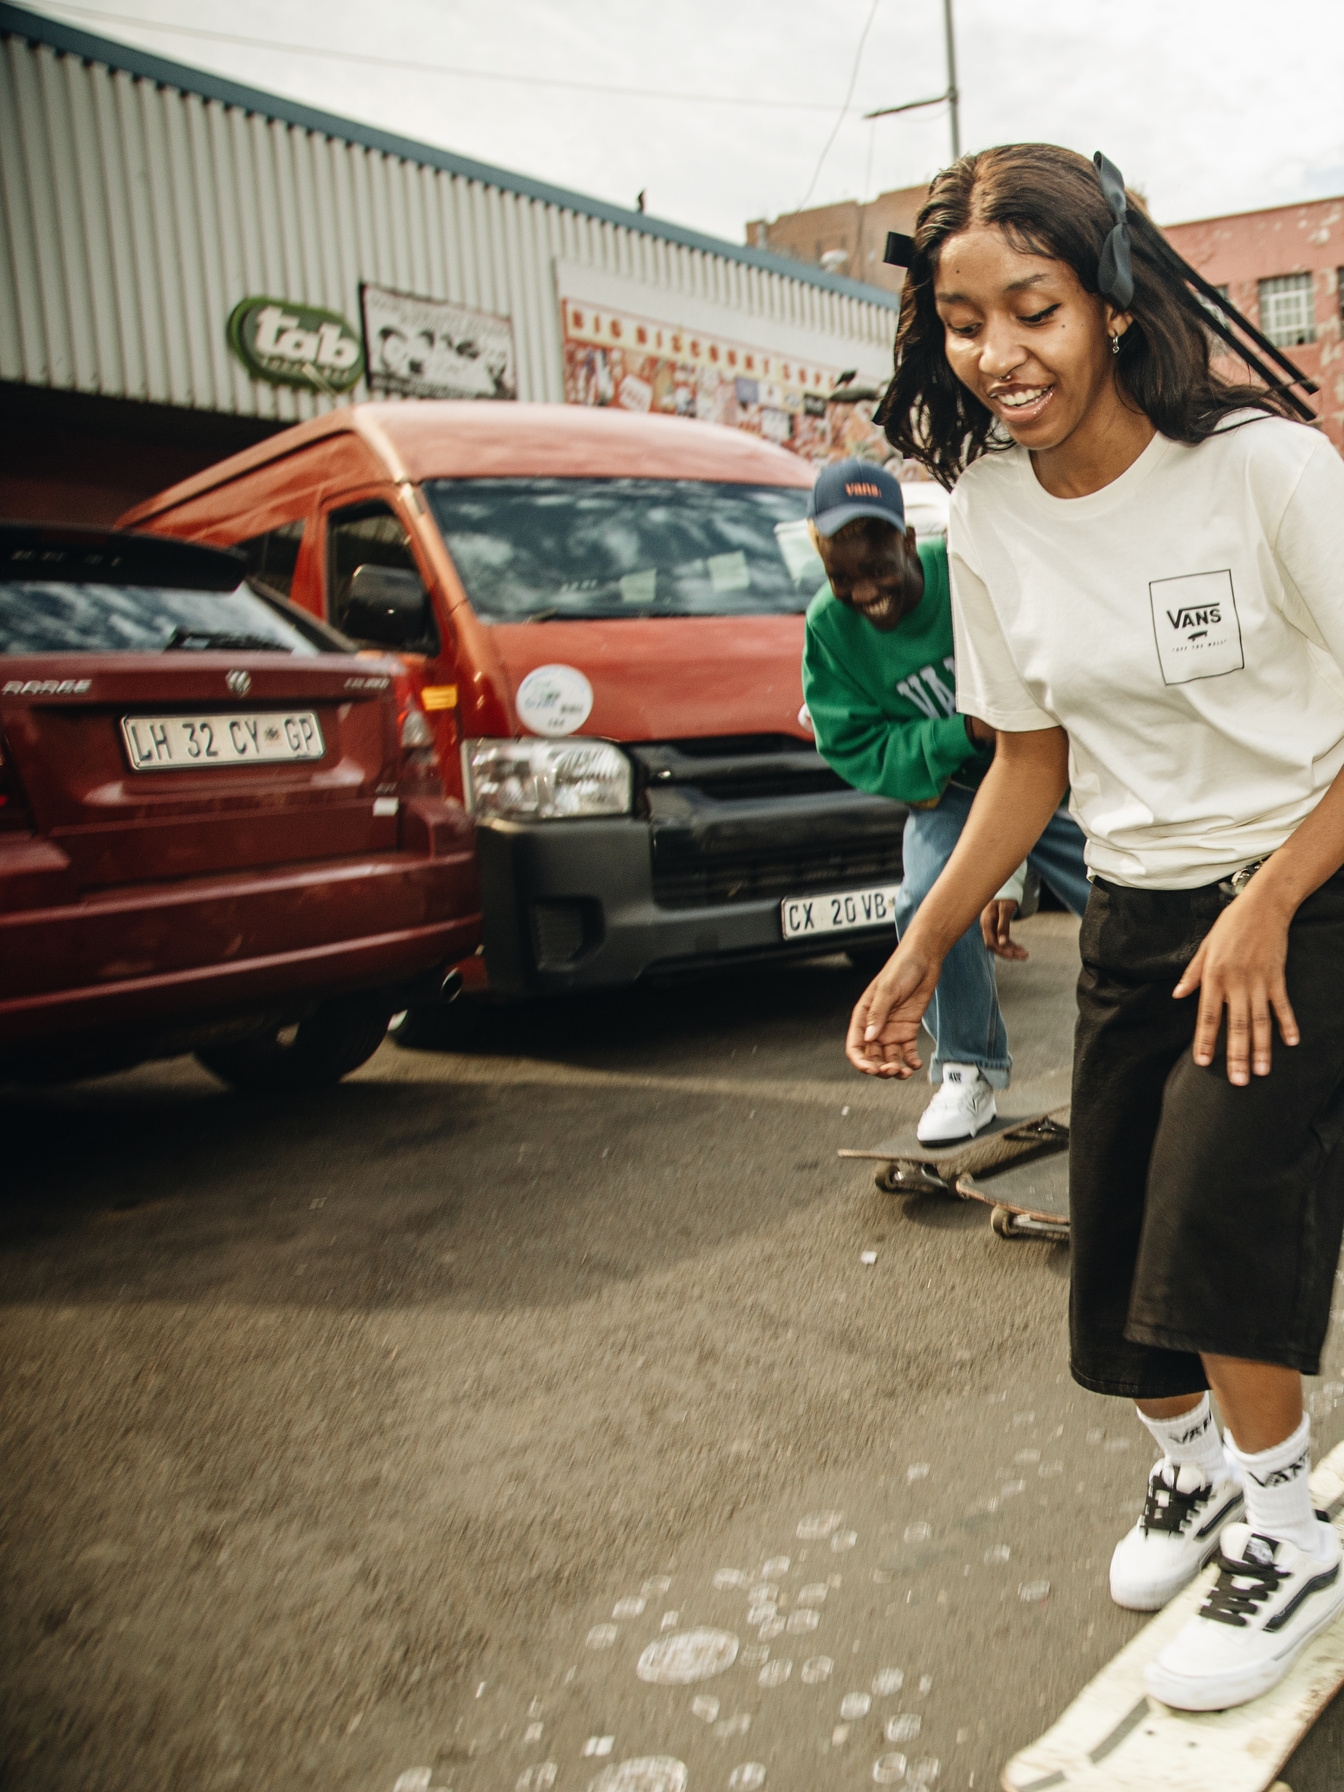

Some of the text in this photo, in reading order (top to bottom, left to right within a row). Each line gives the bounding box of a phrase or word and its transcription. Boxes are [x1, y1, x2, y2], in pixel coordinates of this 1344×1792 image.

[254, 305, 360, 369] tab
[1166, 602, 1222, 630] VANS
[130, 717, 313, 762] LH 32 CY GP
[789, 893, 887, 931] CX 20 VB
